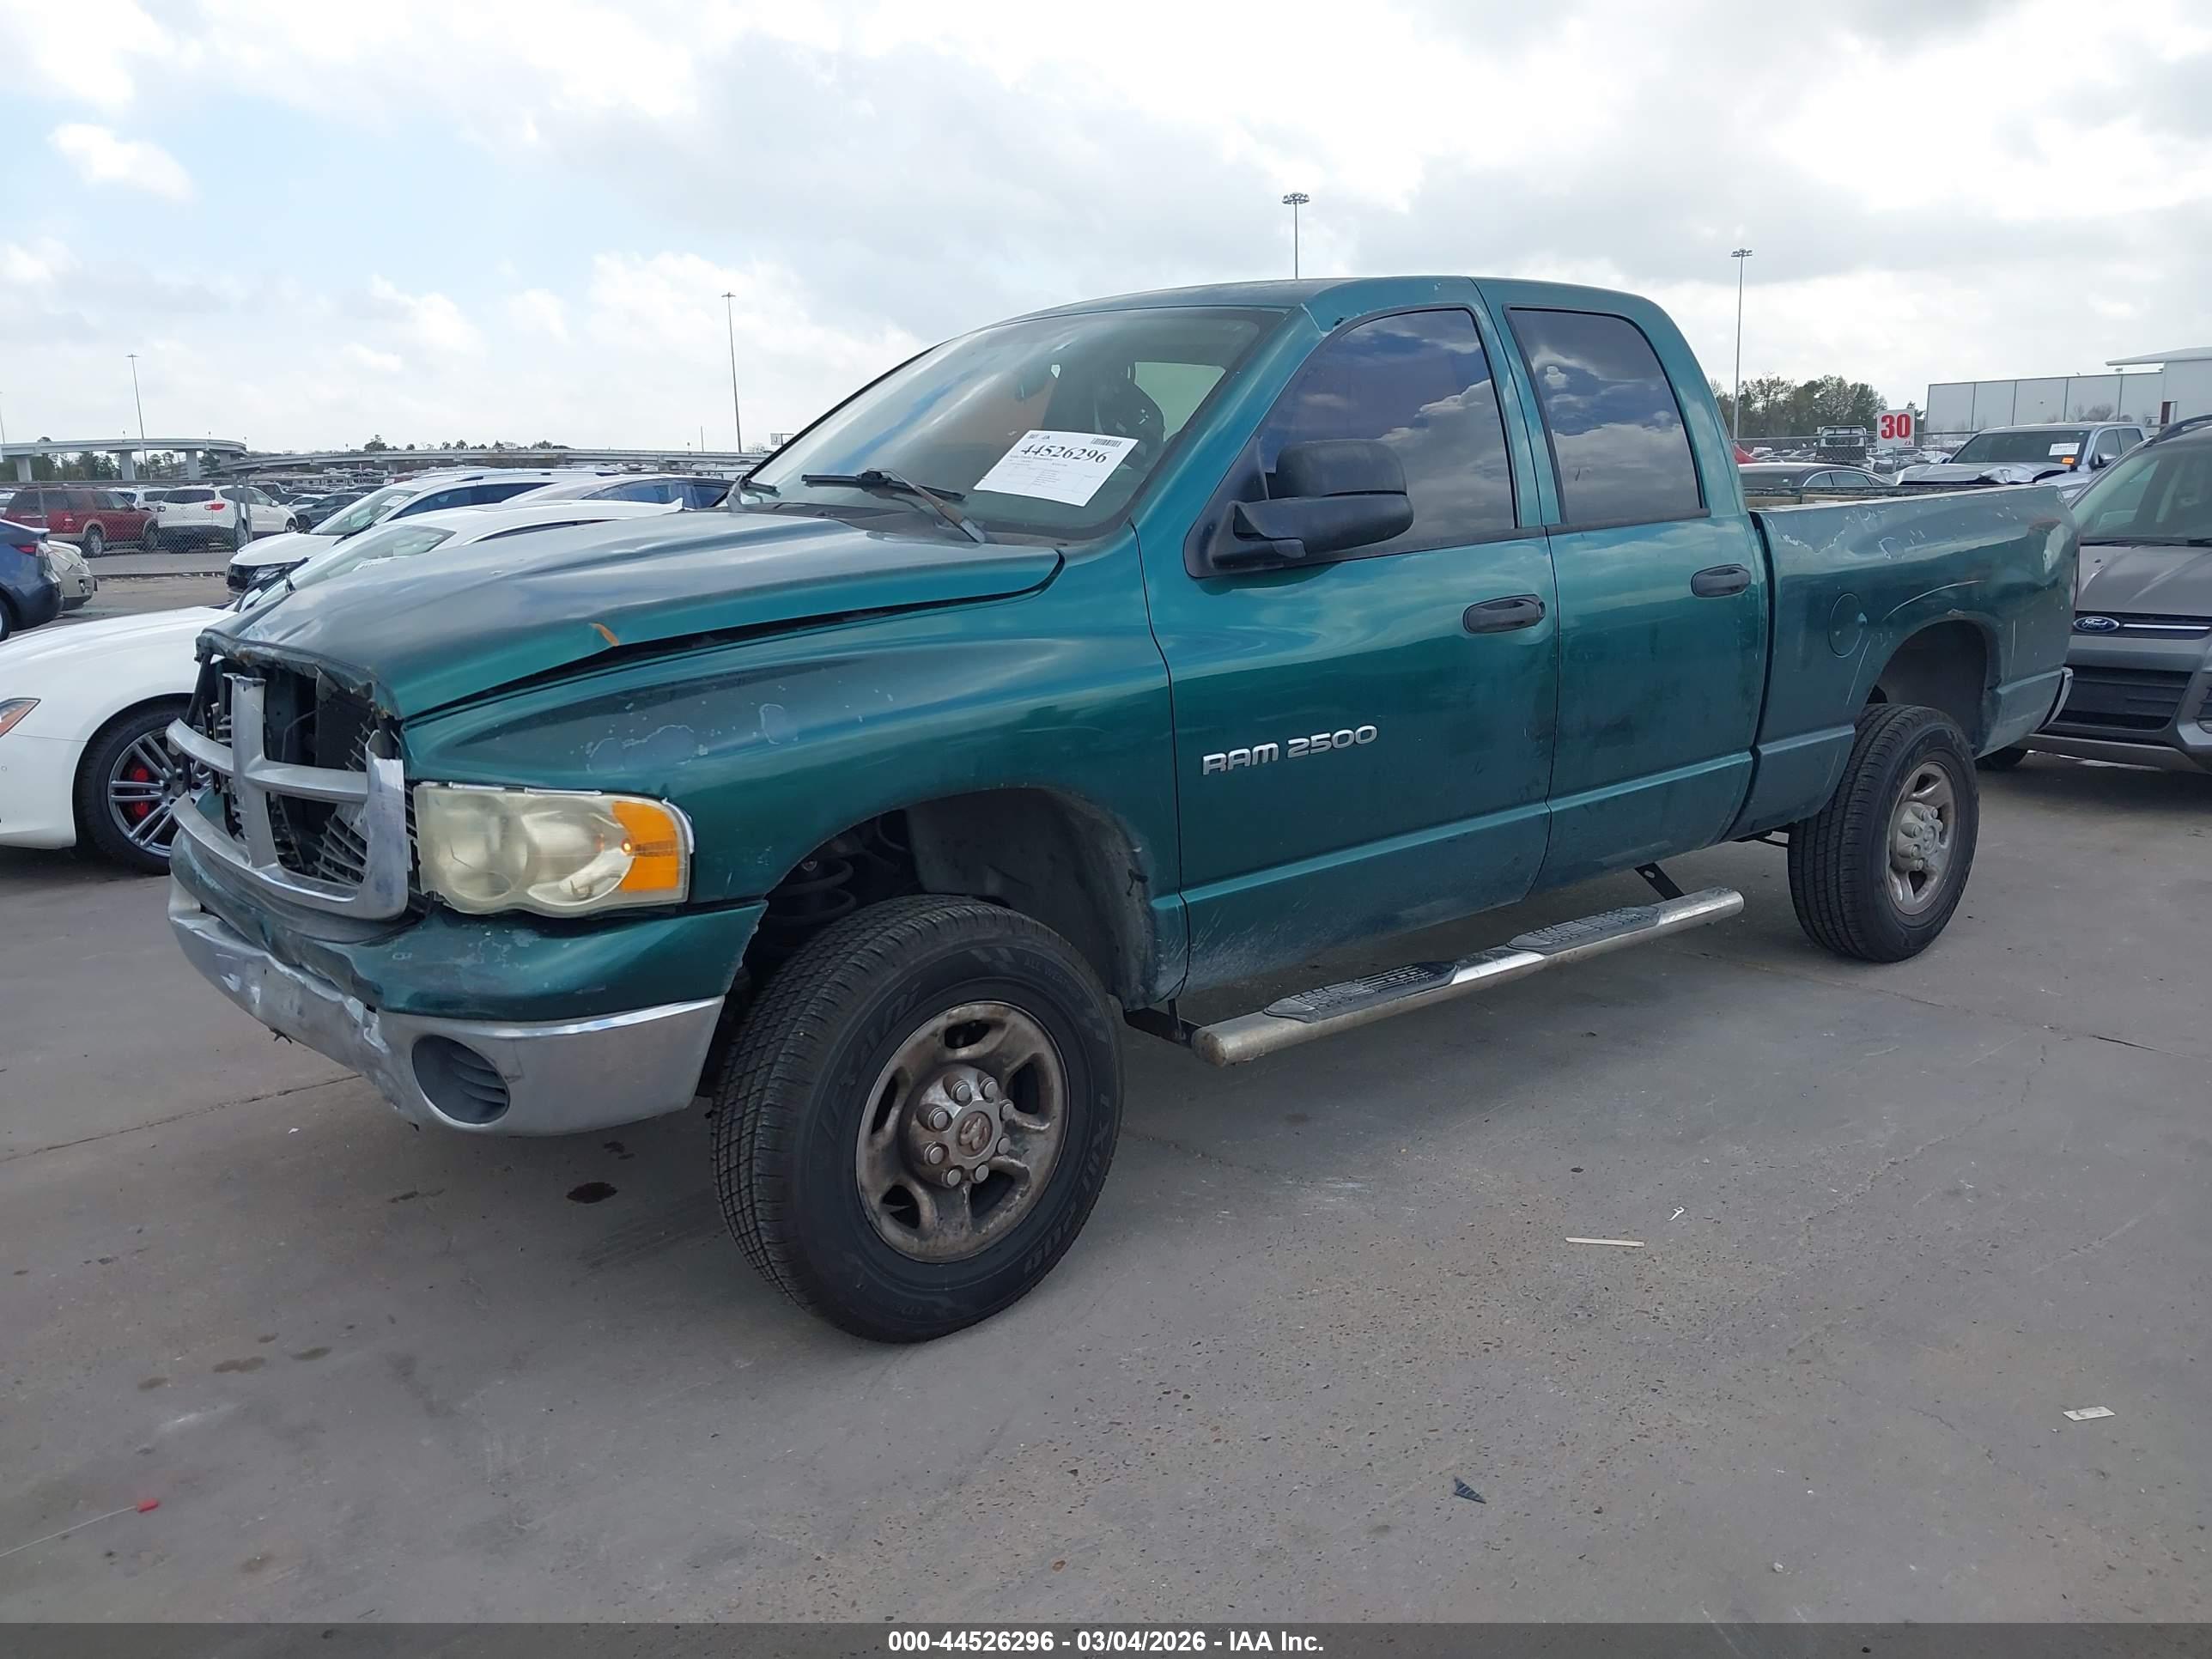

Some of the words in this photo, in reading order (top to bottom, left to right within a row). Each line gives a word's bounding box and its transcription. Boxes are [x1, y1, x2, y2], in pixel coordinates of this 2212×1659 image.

[1881, 413, 1911, 439] 30
[1020, 444, 1113, 464] 44526296
[1202, 743, 1279, 776] RAM
[1287, 725, 1378, 758] 2500
